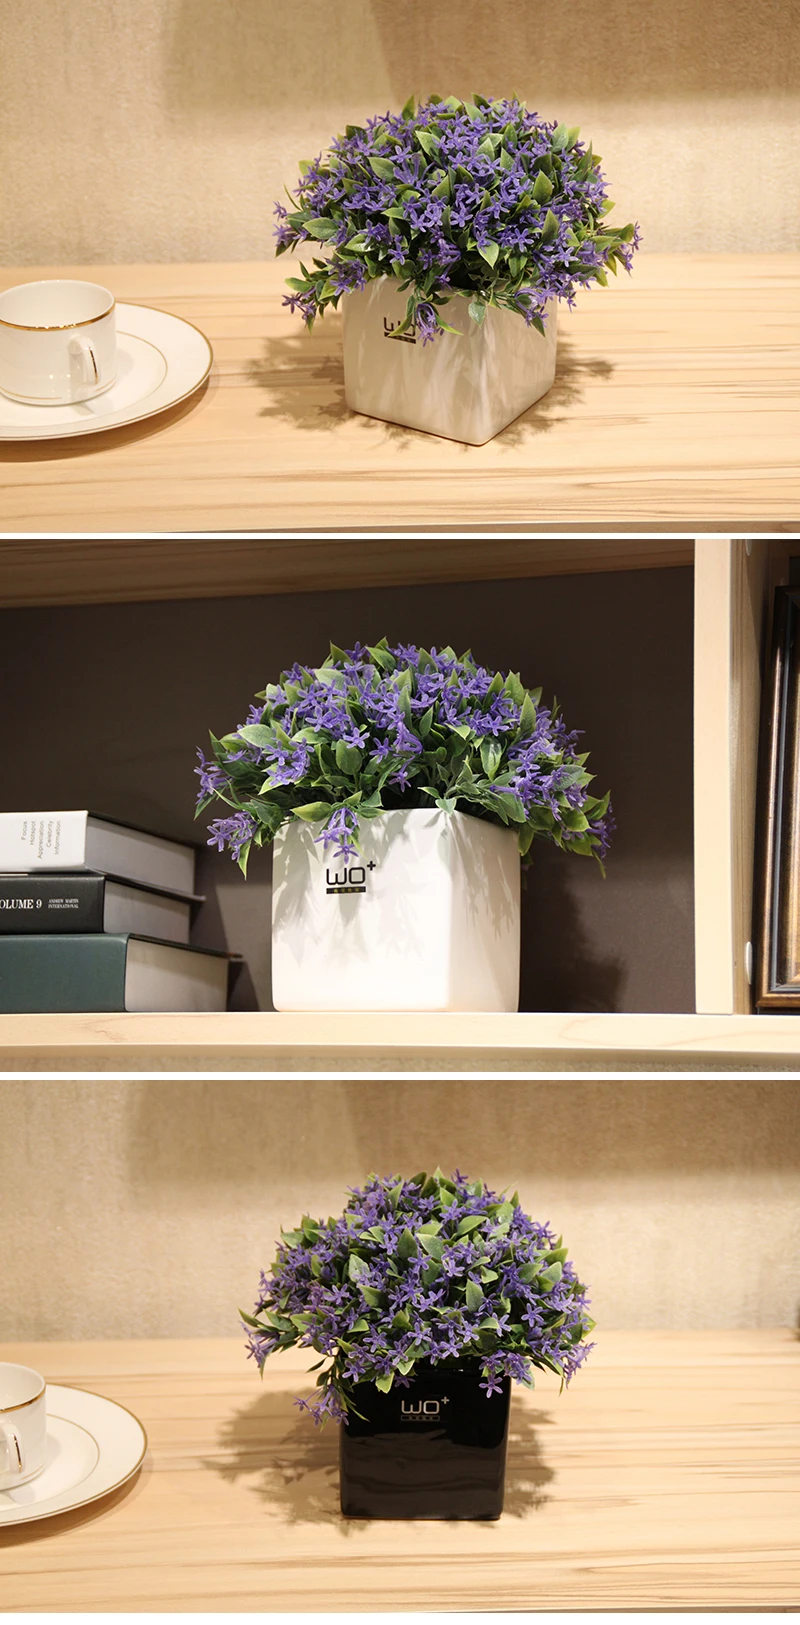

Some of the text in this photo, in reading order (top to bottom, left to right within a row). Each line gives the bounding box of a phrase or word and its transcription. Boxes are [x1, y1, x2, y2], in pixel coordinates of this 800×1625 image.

[29, 820, 37, 846] Hotspot
[37, 820, 45, 859] Appreciation
[46, 820, 54, 848] Celebrity
[36, 898, 43, 909] 9
